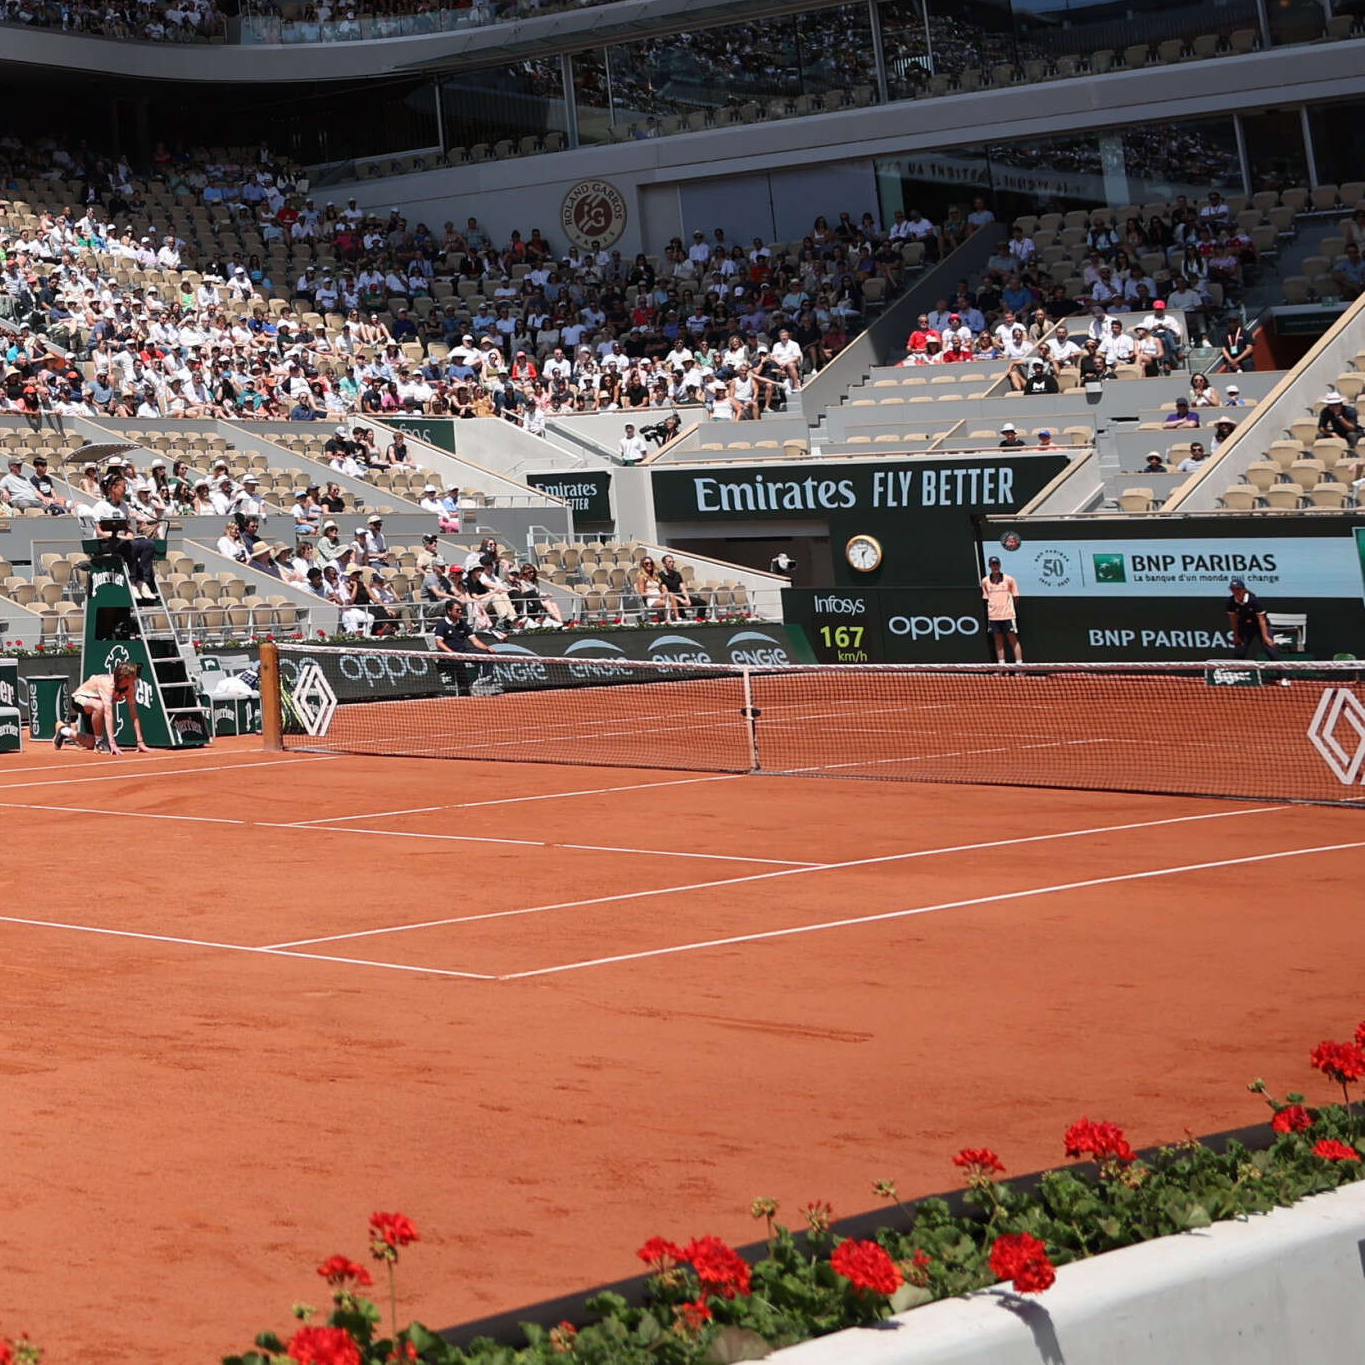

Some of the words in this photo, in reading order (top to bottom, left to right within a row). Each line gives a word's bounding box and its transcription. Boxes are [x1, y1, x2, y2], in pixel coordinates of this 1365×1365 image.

[564, 184, 589, 226] ROLAND
[592, 183, 623, 219] GARROS
[535, 482, 598, 497] Emirates
[695, 476, 856, 513] Emirates
[872, 469, 912, 508] FLY
[921, 466, 1015, 506] BETTER
[1043, 559, 1064, 577] 50
[1131, 554, 1176, 572] BNP
[1181, 553, 1277, 572] PARIBAS
[1145, 575, 1176, 583] banque
[1199, 574, 1228, 582] monde
[1247, 574, 1279, 584] change
[814, 595, 865, 616] Infosys
[820, 626, 864, 648] 167
[888, 616, 980, 641] oppo
[1089, 629, 1135, 647] BNP
[1141, 630, 1236, 648] PARIBAS
[838, 650, 868, 662] km/h
[339, 654, 428, 688] oppo
